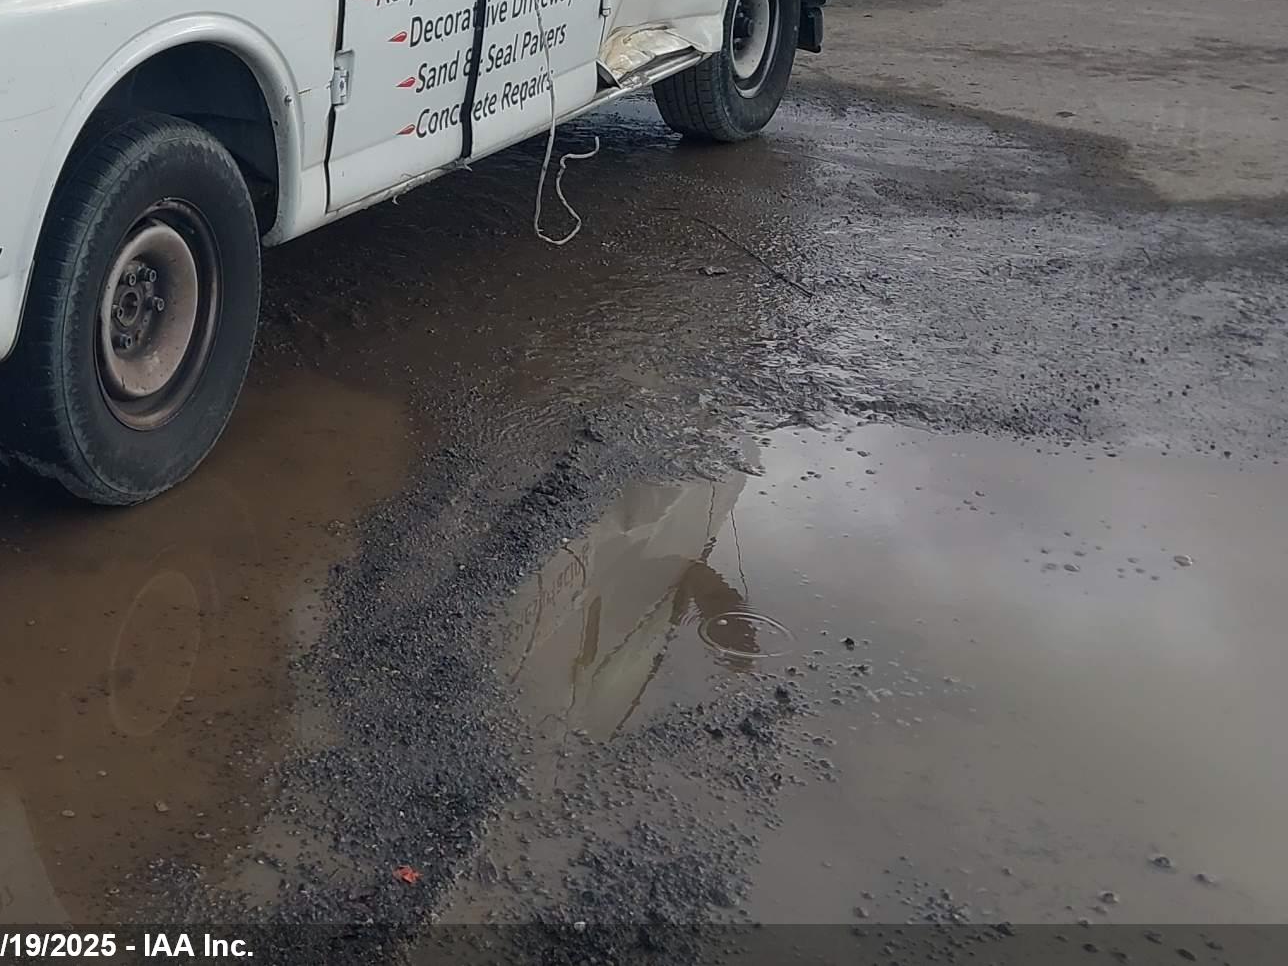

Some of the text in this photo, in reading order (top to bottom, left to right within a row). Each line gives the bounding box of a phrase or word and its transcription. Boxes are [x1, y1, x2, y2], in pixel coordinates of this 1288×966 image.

[415, 50, 461, 94] Sand
[485, 33, 518, 74] Seal
[520, 23, 567, 60] Pavers
[416, 93, 498, 139] Concete
